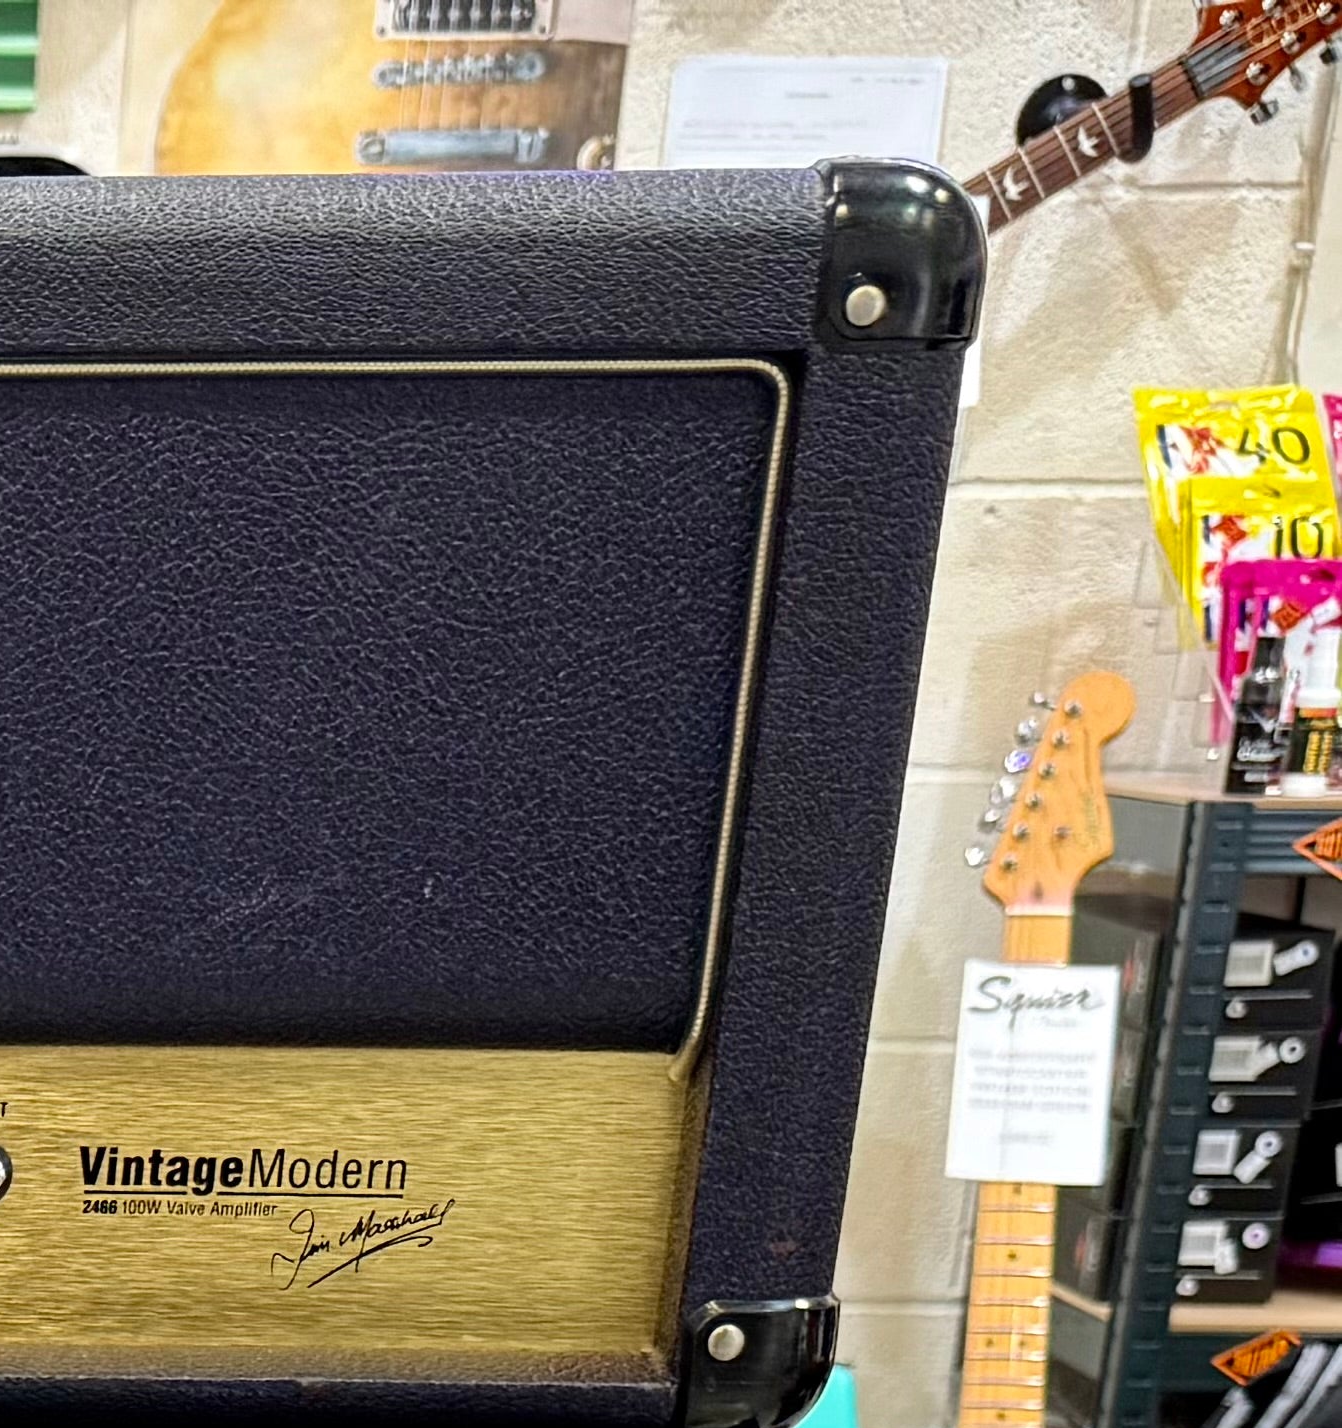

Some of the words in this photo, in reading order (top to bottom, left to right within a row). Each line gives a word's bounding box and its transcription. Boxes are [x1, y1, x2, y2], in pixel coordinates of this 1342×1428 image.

[968, 975, 1106, 1031] Squier
[79, 1145, 407, 1195] VintageModern
[82, 1199, 118, 1215] 2466
[122, 1199, 162, 1215] 100W
[167, 1200, 206, 1216] Valve
[210, 1201, 279, 1219] Amplifier
